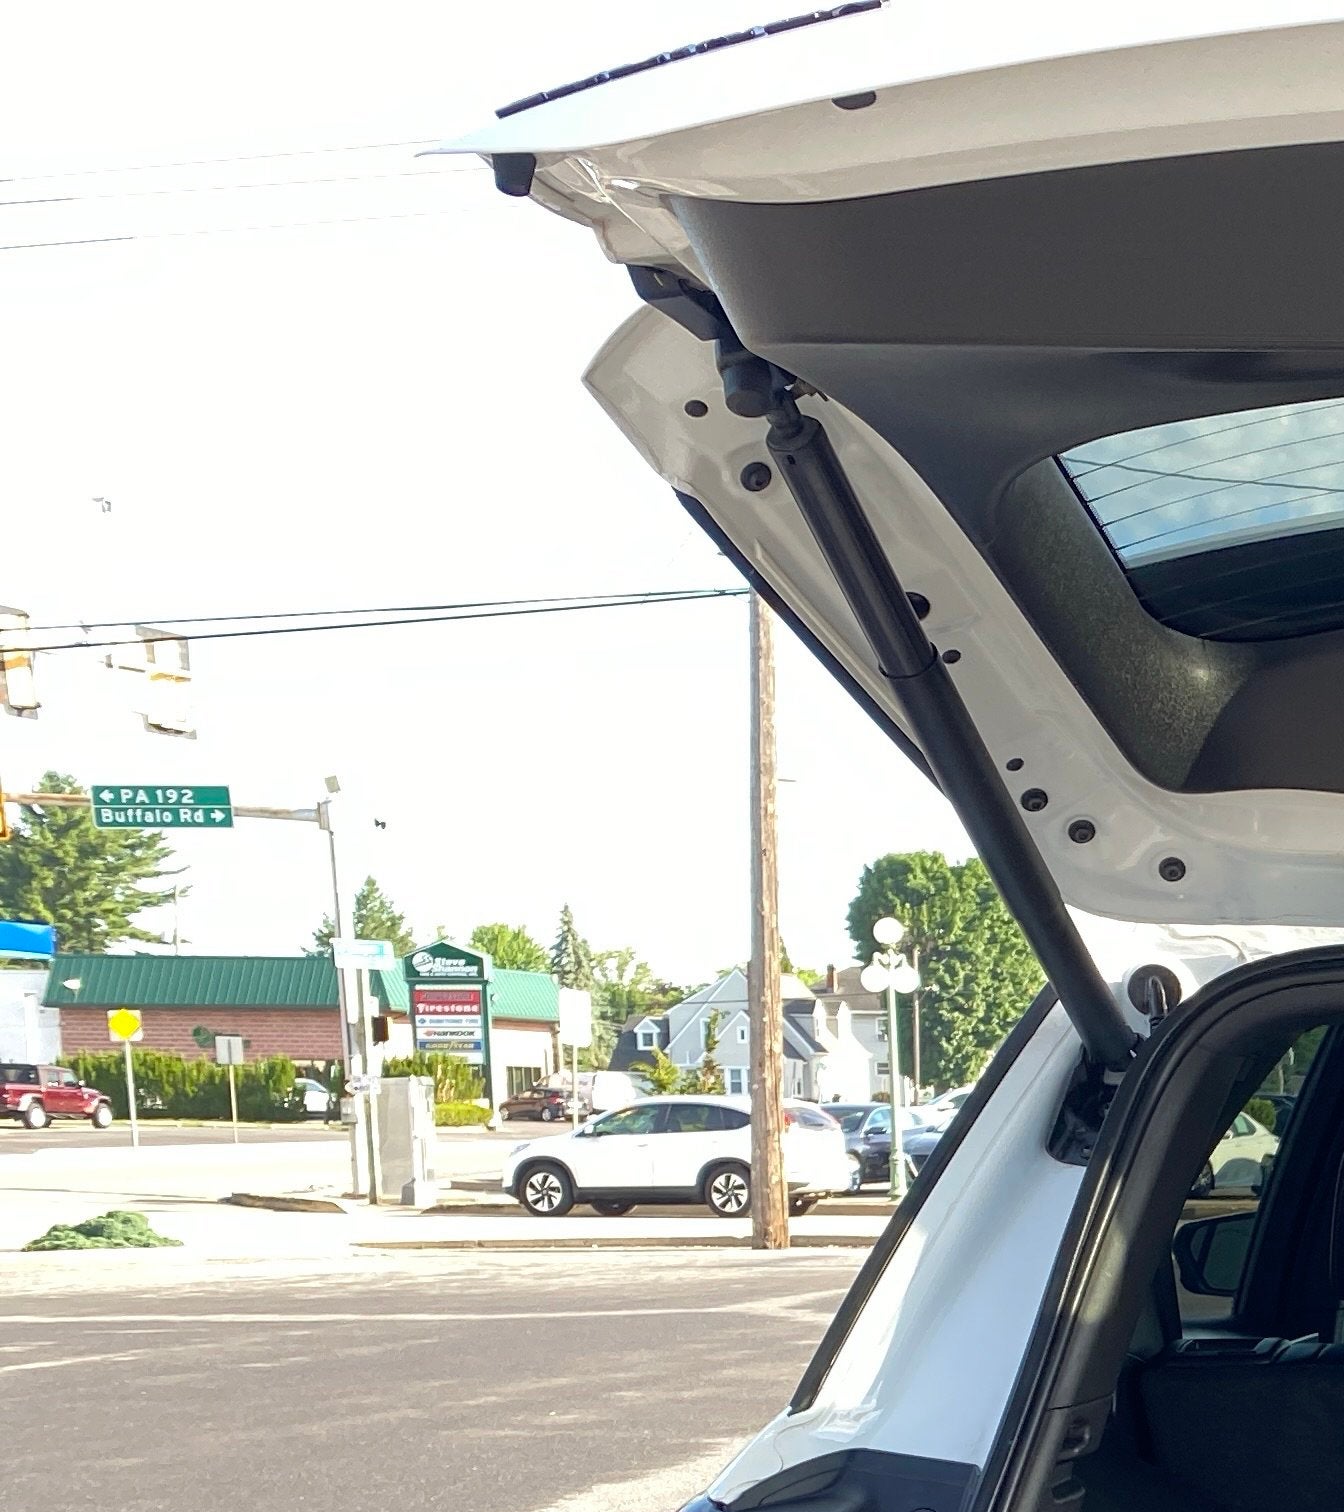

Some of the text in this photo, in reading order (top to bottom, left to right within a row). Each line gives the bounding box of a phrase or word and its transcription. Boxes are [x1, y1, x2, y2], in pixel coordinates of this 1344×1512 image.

[120, 788, 195, 804] PA 192
[100, 808, 205, 823] Buffalo Rd
